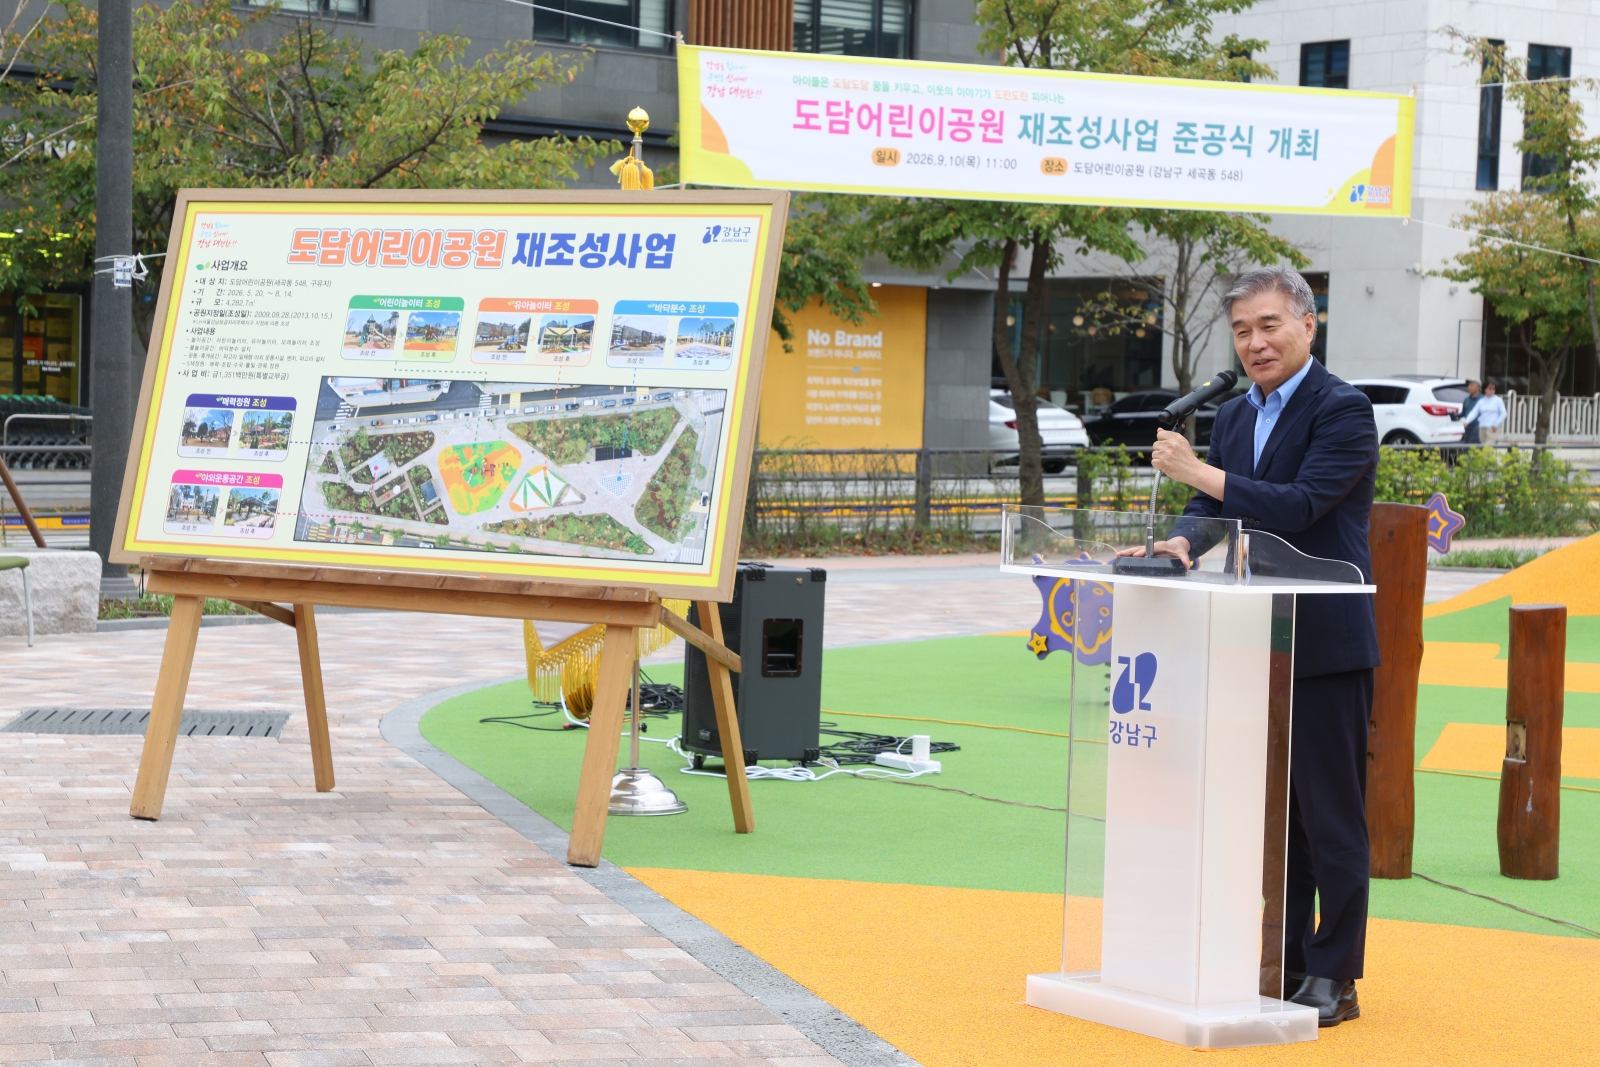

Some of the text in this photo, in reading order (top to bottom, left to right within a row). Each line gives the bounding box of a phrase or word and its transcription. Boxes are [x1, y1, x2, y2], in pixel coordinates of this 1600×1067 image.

[792, 76, 830, 88] 아이들은
[833, 78, 868, 90] 도담도담
[873, 80, 890, 92] 꿈을
[927, 85, 954, 96] 이웃의
[957, 86, 991, 99] 이야기가
[994, 90, 1028, 102] 도란도란
[1032, 92, 1066, 104] 피어나는
[792, 99, 1320, 160] 도담어린이공원 재조성사업 준공식 개최
[876, 150, 1017, 170] 일시 2026.9.10(목) 11:00
[1044, 160, 1244, 182] 장소 도담어린이공원 (강남구 세곡동 548)
[723, 226, 751, 237] 강남구
[288, 228, 676, 269] 도담어린이공원 재조성사업
[211, 260, 248, 271] 사업개요
[230, 278, 292, 287] 도담어린이공원(세곡동
[380, 298, 441, 308] 어린이놀이터 조성
[514, 301, 570, 311] 유아놀이터 조성
[654, 303, 705, 314] 바닥분수 조성
[194, 309, 252, 318] 공원지정일(조성일):
[807, 329, 882, 348] No Brand
[252, 398, 267, 408] 조성
[201, 473, 260, 484] 야외운동공간 조성
[1110, 720, 1158, 748] 강남구
